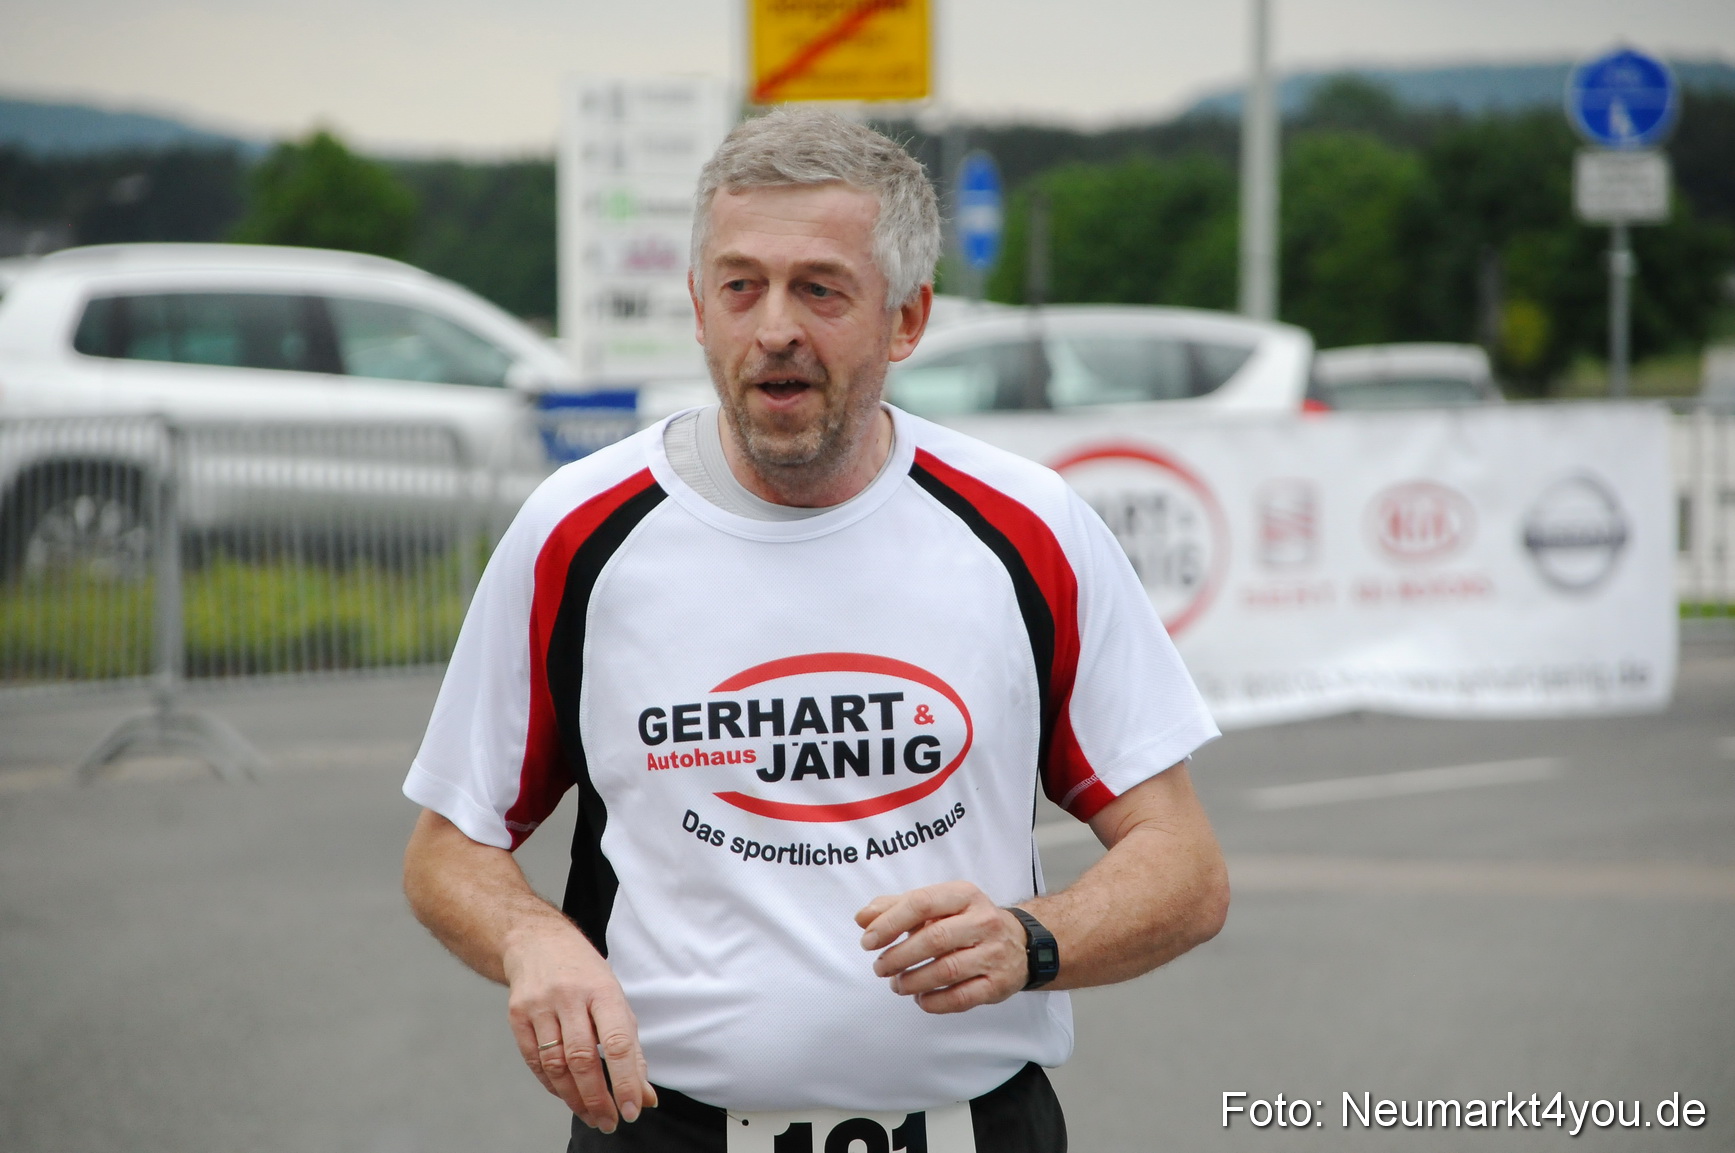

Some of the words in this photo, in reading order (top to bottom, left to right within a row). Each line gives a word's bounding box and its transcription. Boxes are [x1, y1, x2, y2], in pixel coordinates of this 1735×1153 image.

[638, 691, 904, 746] GERHART
[913, 703, 935, 725] &
[646, 746, 757, 771] Autohaus
[756, 734, 942, 783] JÄNIG
[681, 808, 726, 847] Das
[729, 835, 859, 866] sportliche
[865, 800, 967, 861] Autohaus
